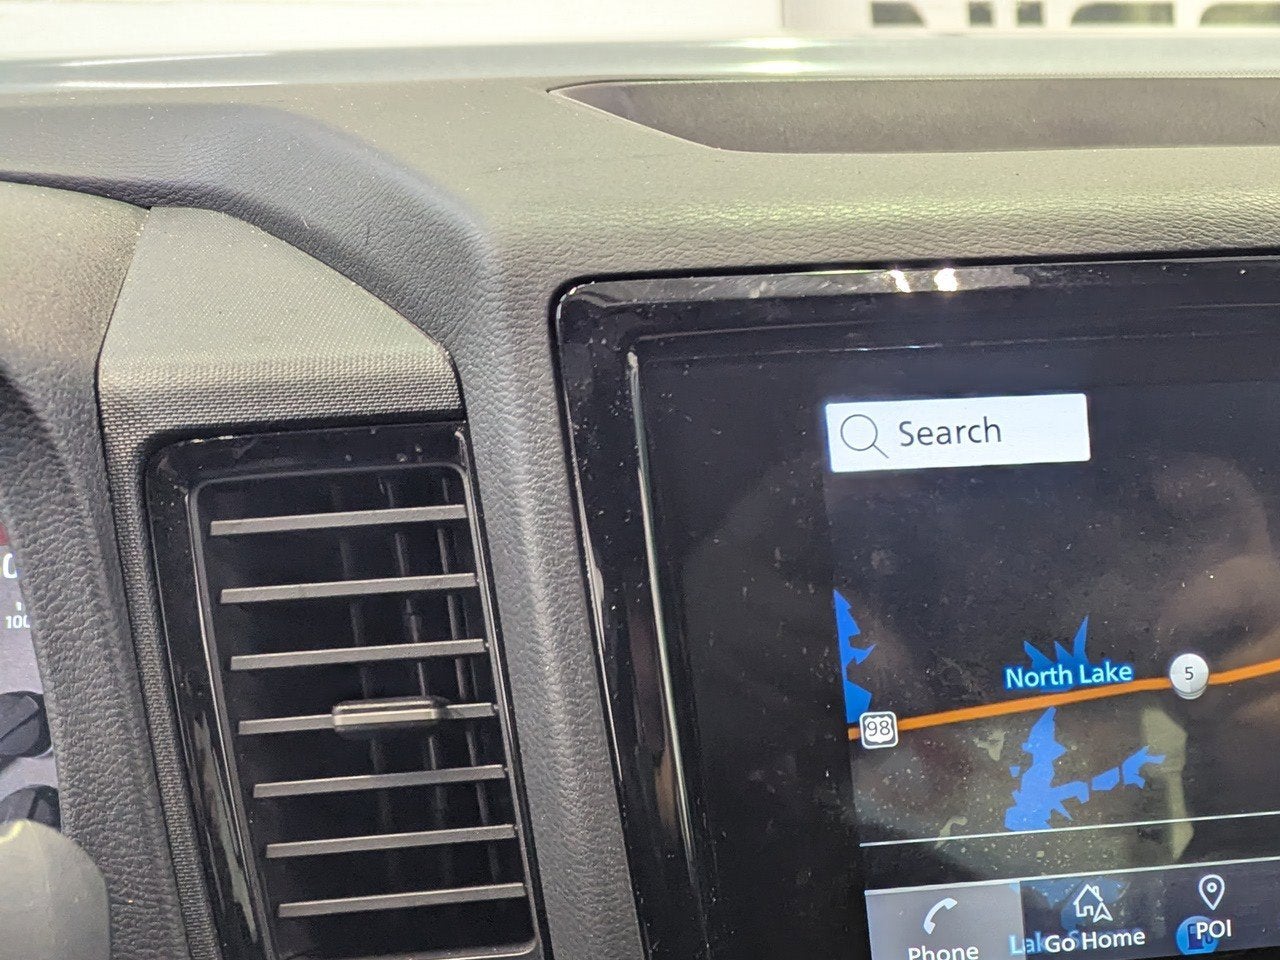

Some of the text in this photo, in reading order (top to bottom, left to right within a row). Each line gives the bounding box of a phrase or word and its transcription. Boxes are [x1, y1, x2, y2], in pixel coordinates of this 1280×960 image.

[899, 415, 1002, 447] Search
[1005, 661, 1133, 688] North Lake
[1184, 666, 1194, 681] 5
[866, 720, 890, 738] 98
[1196, 919, 1232, 939] POI
[1044, 934, 1077, 954] Go
[1081, 930, 1147, 951] Home
